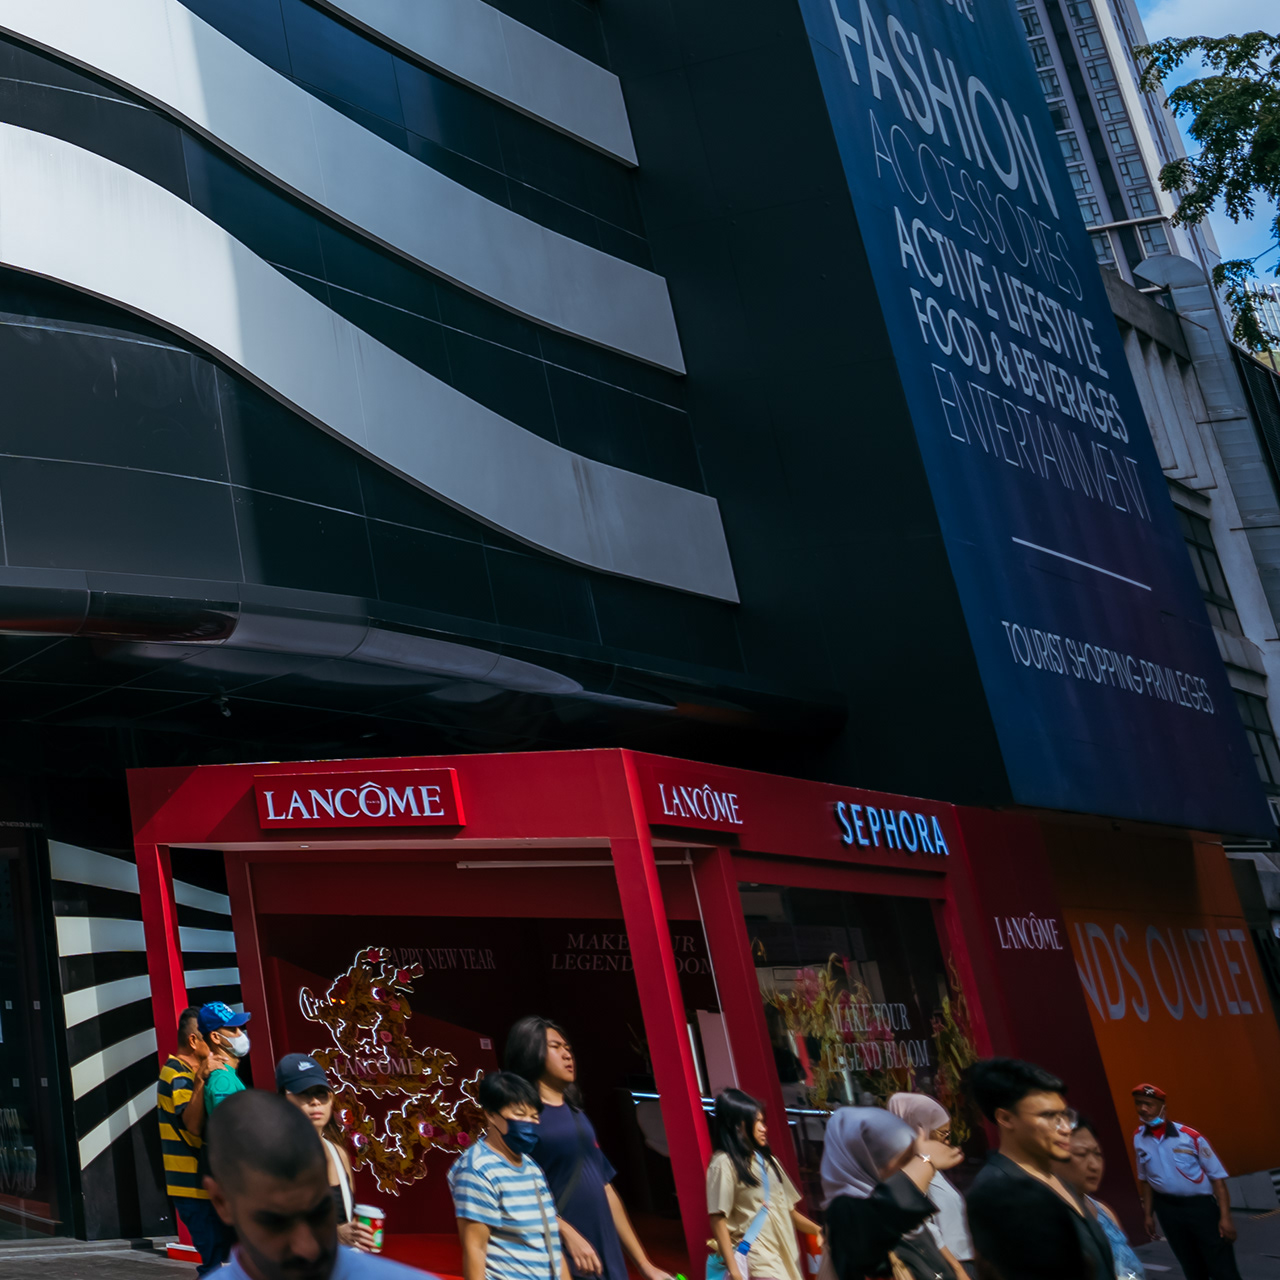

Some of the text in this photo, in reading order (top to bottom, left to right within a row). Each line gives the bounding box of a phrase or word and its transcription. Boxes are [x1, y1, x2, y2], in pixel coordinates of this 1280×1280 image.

[868, 109, 1084, 302] ACCESSORIES
[893, 205, 1110, 381] ACTIVE LIFESTYLE
[909, 286, 1130, 445] FOOD & BEVERAGES
[930, 362, 1153, 523] ENTERTAINMENT
[1000, 619, 1215, 715] TOURIST SHOPPING PRIVILEGES
[262, 780, 445, 820] LANCÔME
[657, 783, 744, 825] LANCÔME
[834, 800, 950, 856] SEPHORA
[567, 932, 630, 951] MAKE
[993, 910, 1064, 950] LANCÔME
[386, 948, 497, 970] APPY NEW YEAR
[551, 953, 634, 972] LEGEND
[1144, 924, 1264, 1021] OUTLET
[829, 1002, 911, 1033] MAKE YOUR
[824, 1038, 931, 1073] LEGEND BLOOM
